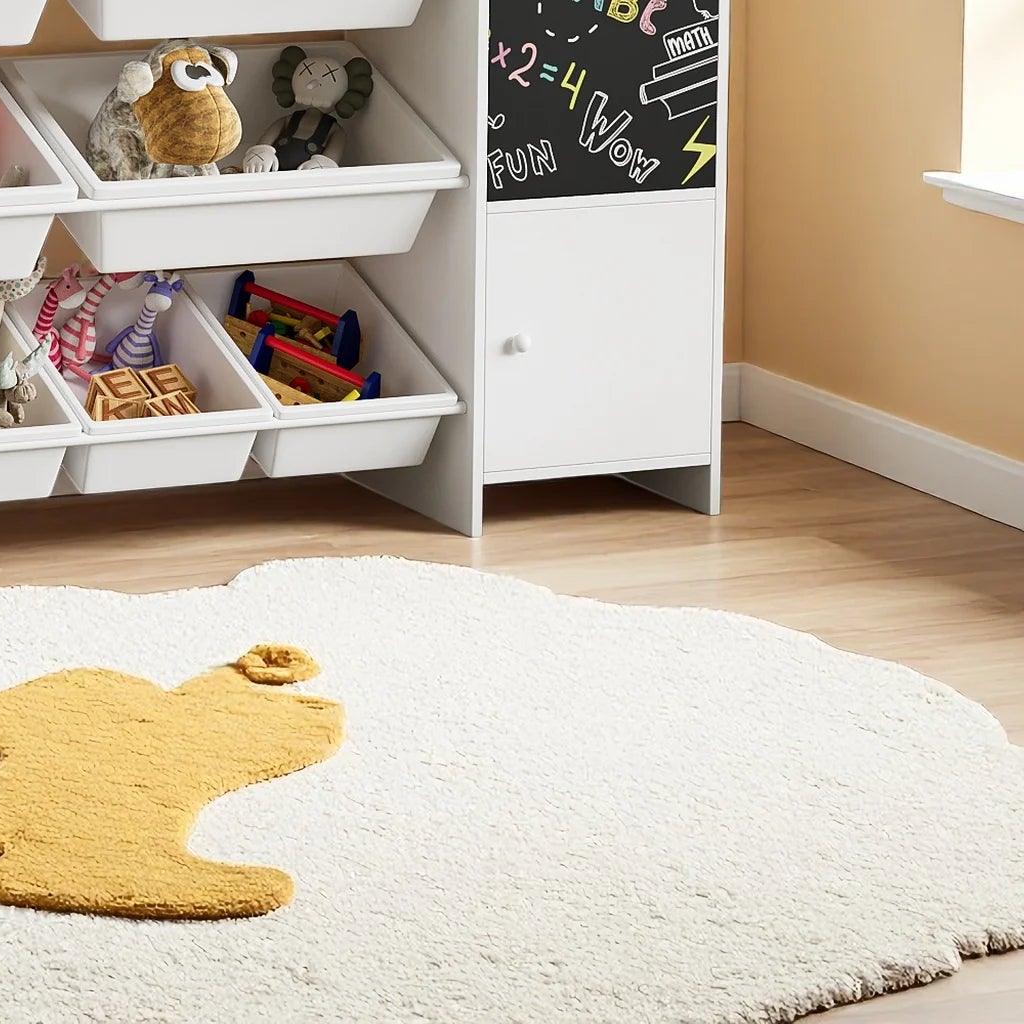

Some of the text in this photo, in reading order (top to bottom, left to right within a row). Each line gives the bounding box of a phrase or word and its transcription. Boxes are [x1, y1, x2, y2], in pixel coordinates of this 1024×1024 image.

[486, 139, 558, 190] FUN
[100, 370, 143, 398] E
[146, 367, 188, 395] E
